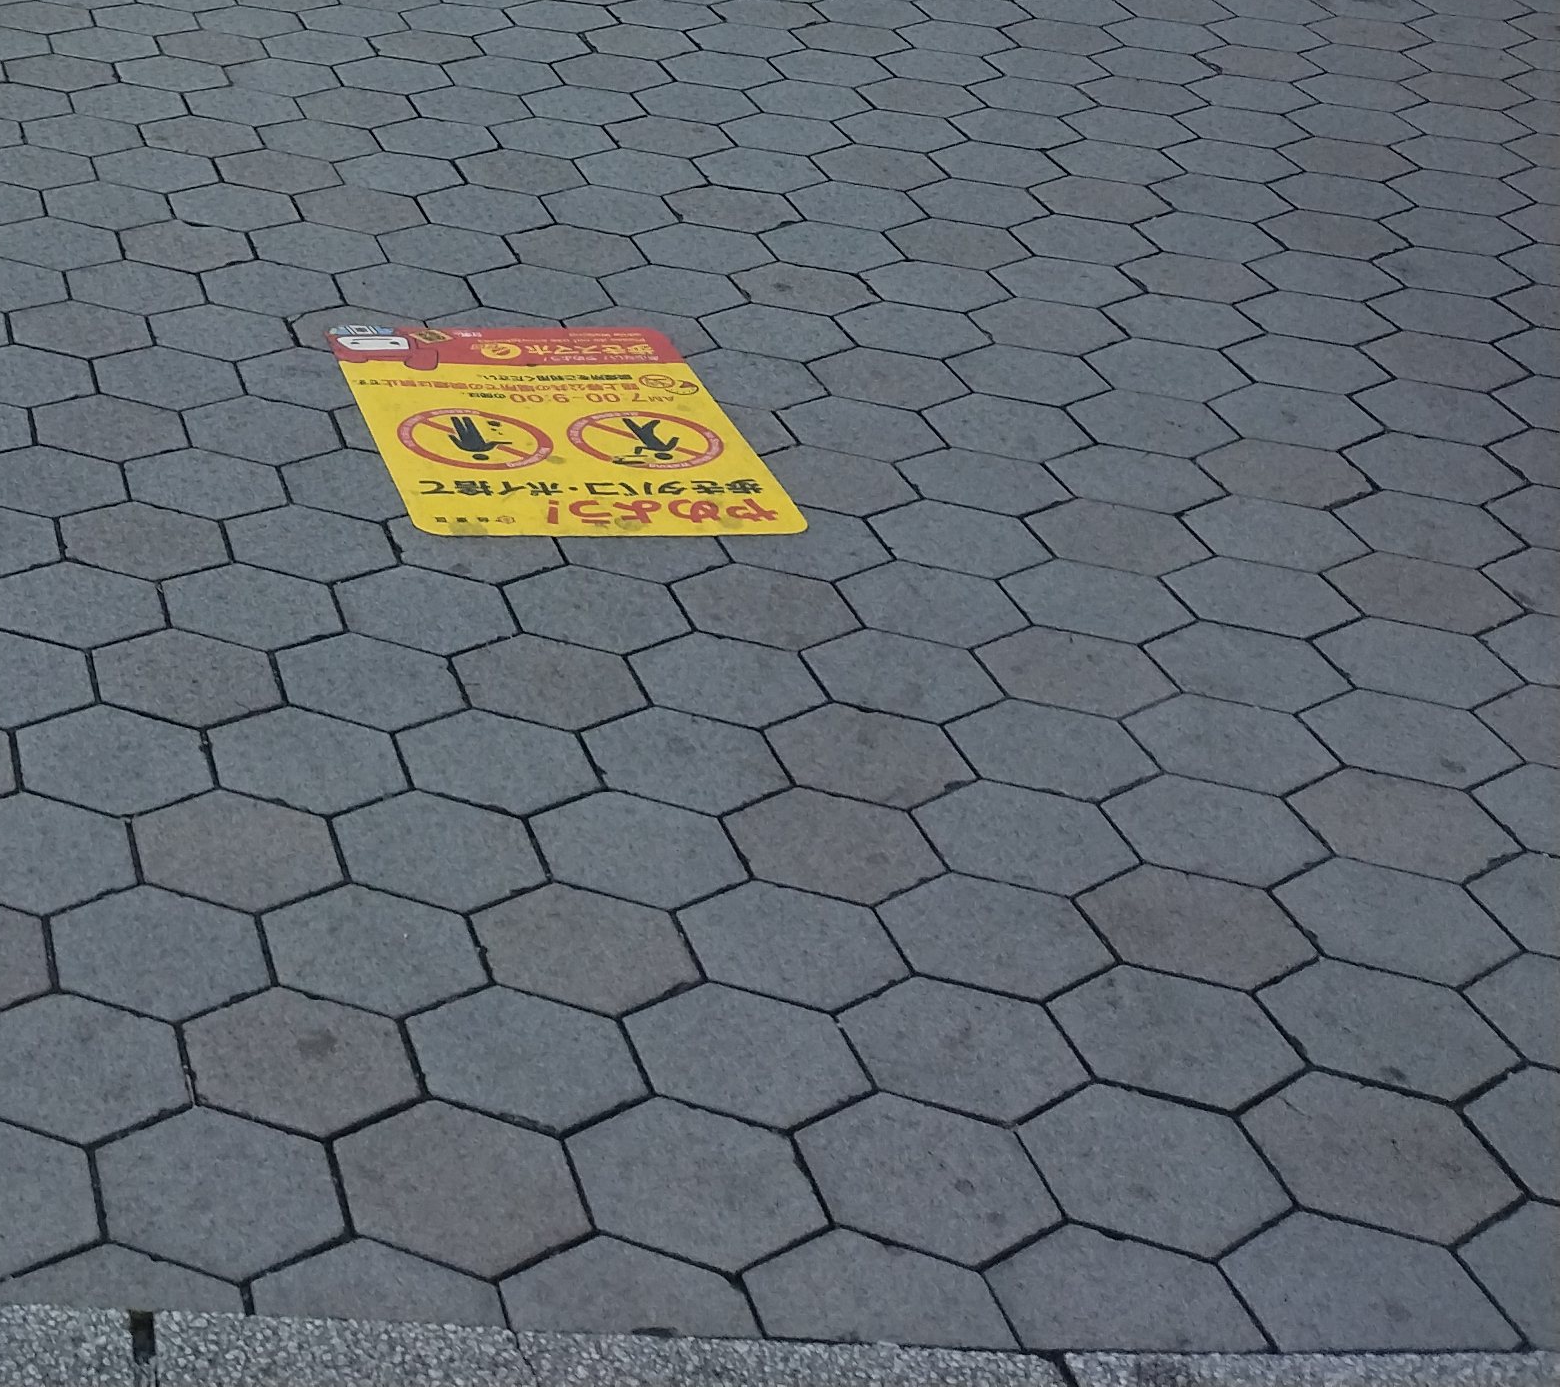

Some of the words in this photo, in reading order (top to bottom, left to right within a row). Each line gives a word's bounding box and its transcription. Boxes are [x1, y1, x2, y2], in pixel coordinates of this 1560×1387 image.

[522, 344, 656, 353] 歩きスマホ
